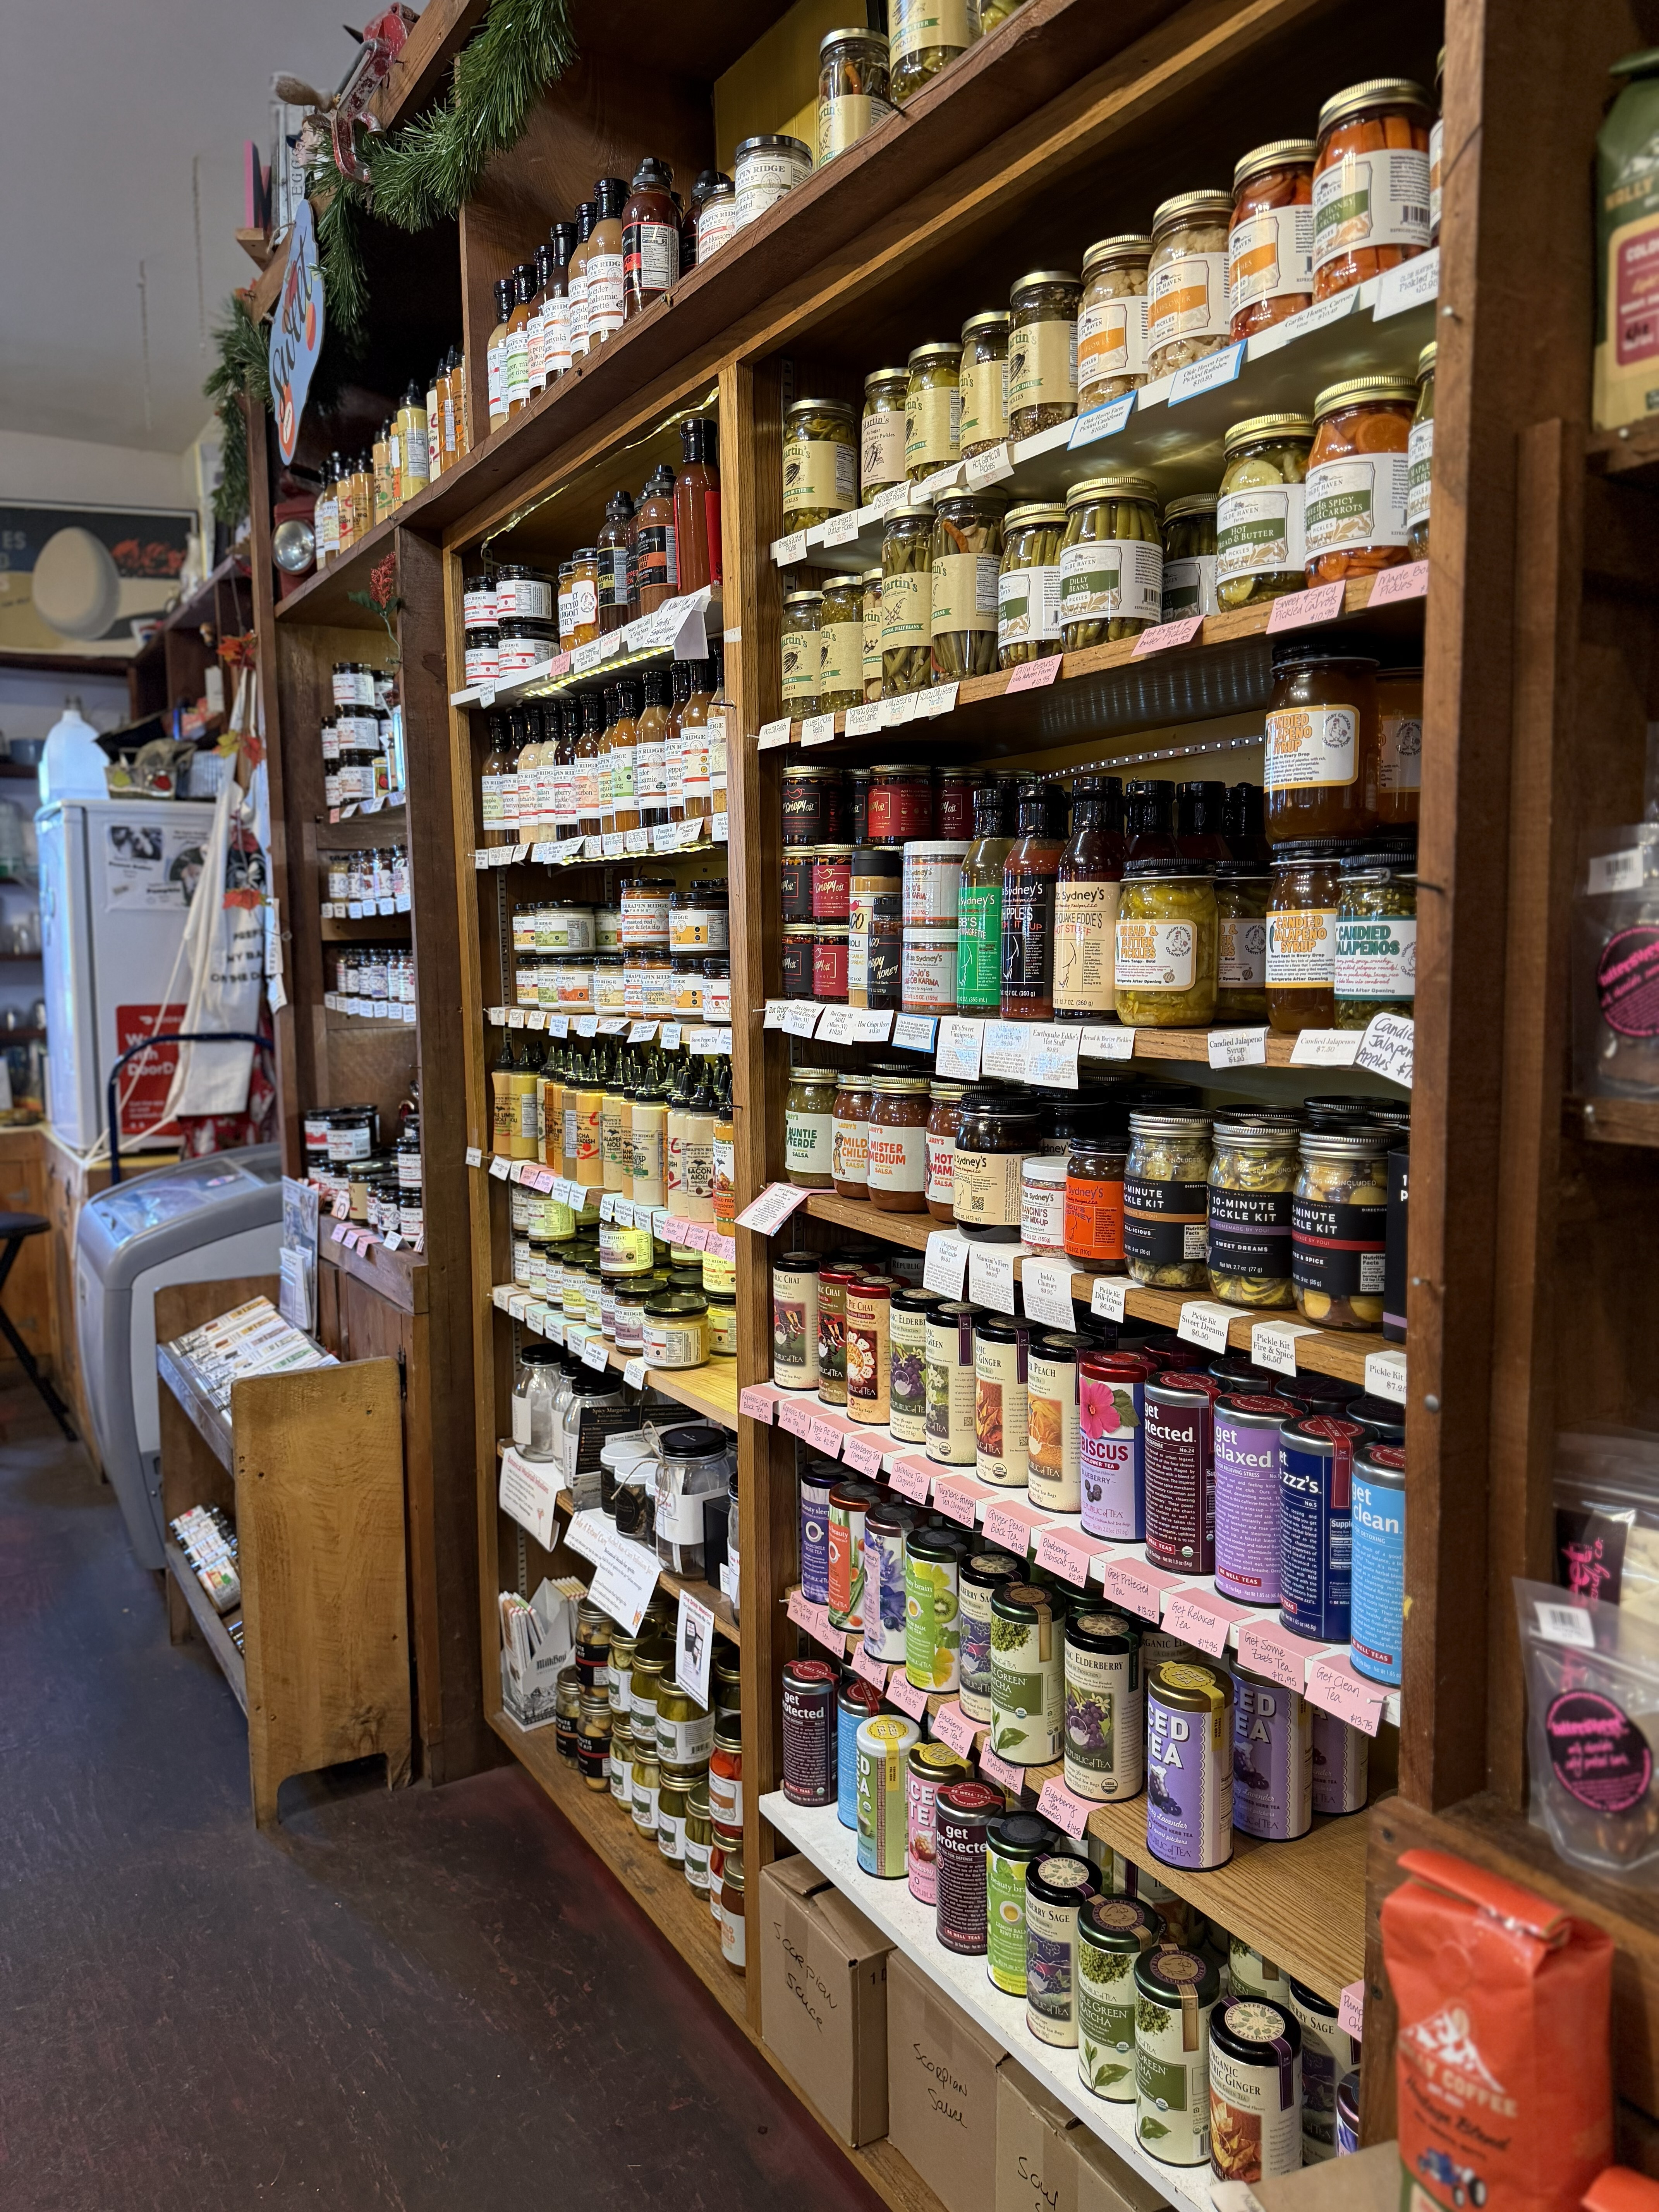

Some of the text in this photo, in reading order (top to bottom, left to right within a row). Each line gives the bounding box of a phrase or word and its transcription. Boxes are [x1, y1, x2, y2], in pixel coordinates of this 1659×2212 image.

[1284, 292, 1354, 328] Garlic Honey Carrots
[1215, 353, 1230, 365] Farm
[1321, 479, 1343, 491] HAVEN
[1328, 496, 1354, 508] SPICY
[1223, 507, 1259, 521] OLDE HAVEN
[1322, 504, 1363, 518] CARROTS
[1231, 525, 1247, 536] HOT
[1312, 522, 1333, 534] PICKLES
[1241, 529, 1274, 541] BUTTER
[1228, 546, 1250, 557] PICKLES
[1065, 562, 1076, 570] OLDE
[1069, 576, 1088, 586] DILLY
[1378, 573, 1410, 586] Maple
[1069, 583, 1089, 592] BEANS
[1379, 581, 1412, 597] Pickles
[1069, 594, 1088, 602] PICKLES
[1275, 605, 1302, 621] Pickled
[1309, 608, 1335, 622] $10.95
[1143, 623, 1184, 639] Hot Bread
[1162, 627, 1192, 641] Pickles
[1077, 913, 1102, 928] EDDIE'S
[1276, 915, 1324, 929] CANDIED
[1120, 925, 1159, 936] BREAD &
[1274, 927, 1328, 941] JALAPENO
[1339, 925, 1391, 940] CANDIED
[1122, 936, 1154, 947] BUTTER
[1281, 940, 1316, 953] SYRUP
[1121, 947, 1156, 958] PICKLES
[918, 979, 939, 987] KARMA
[1032, 1029, 1079, 1041] Earthquake Eddie's
[1235, 1036, 1262, 1045] Jalapeno
[1226, 1046, 1245, 1055] Syrup
[1357, 1047, 1391, 1072] Apples
[788, 1128, 817, 1140] AUNTIE
[789, 1137, 816, 1149] VERDE
[843, 1137, 867, 1147] MILD
[871, 1141, 903, 1154] MISTER
[792, 1151, 809, 1159] SALSA
[842, 1146, 869, 1159] CHILD
[934, 1152, 953, 1163] HOT
[874, 1167, 893, 1175] SALSA
[934, 1178, 953, 1188] SALSA
[1146, 1199, 1164, 1209] KIT
[1212, 1196, 1276, 1211] 10-MINUTE
[1212, 1207, 1277, 1222] PICKLE KIT
[1317, 1224, 1338, 1235] KIT
[1216, 1240, 1269, 1253] SWEET DREAMS
[985, 1263, 1001, 1273] Mixup
[998, 1259, 1010, 1270] Fiery
[1305, 1257, 1324, 1266] SPICE
[1040, 1273, 1055, 1282] Indu's
[1037, 1279, 1057, 1290] Chutney
[1099, 1286, 1112, 1296] Pickle
[825, 1286, 840, 1297] CHAI
[857, 1302, 873, 1312] CHAI
[1099, 1302, 1115, 1313] $6.50
[1191, 1311, 1217, 1326] Pickle Kit
[1181, 1314, 1225, 1337] Sweet Dreams
[1191, 1329, 1209, 1341] $6.50
[1256, 1333, 1290, 1350] Pickle Kit
[1253, 1342, 1294, 1361] Fire & Spice
[979, 1352, 1001, 1368] GINGER
[1262, 1353, 1282, 1365] $6.50
[1034, 1363, 1056, 1377] PEACH
[1369, 1364, 1404, 1380] Pickle Kit
[1216, 1425, 1237, 1445] get
[1006, 1530, 1019, 1541] Tea
[1068, 1560, 1080, 1573] Tea
[1068, 1571, 1084, 1583] $12.95
[1108, 1568, 1149, 1595] Get Protected
[1242, 1576, 1258, 1585] TEAS
[1111, 1583, 1125, 1596] Tea
[1137, 1605, 1156, 1619] $13.25
[1174, 1617, 1191, 1630] Tea
[1197, 1638, 1218, 1652] $14.95
[1244, 1632, 1286, 1658] Get Some
[536, 1655, 567, 1670] MilkBoy
[1076, 1654, 1123, 1670] ELDERBERRY
[1171, 1671, 1192, 1686] TEA
[1181, 1667, 1205, 1683] ICED
[1316, 1668, 1360, 1697] Get Clean
[784, 1692, 800, 1704] get
[1324, 1686, 1342, 1704] Tea
[1350, 1713, 1373, 1731] $13.75
[945, 1824, 969, 1839] get
[1048, 1911, 1070, 1923] SAGE
[1098, 2004, 1127, 2019] GREEN
[1310, 2019, 1334, 2035] SAGE
[1225, 2075, 1261, 2096] GINGER
